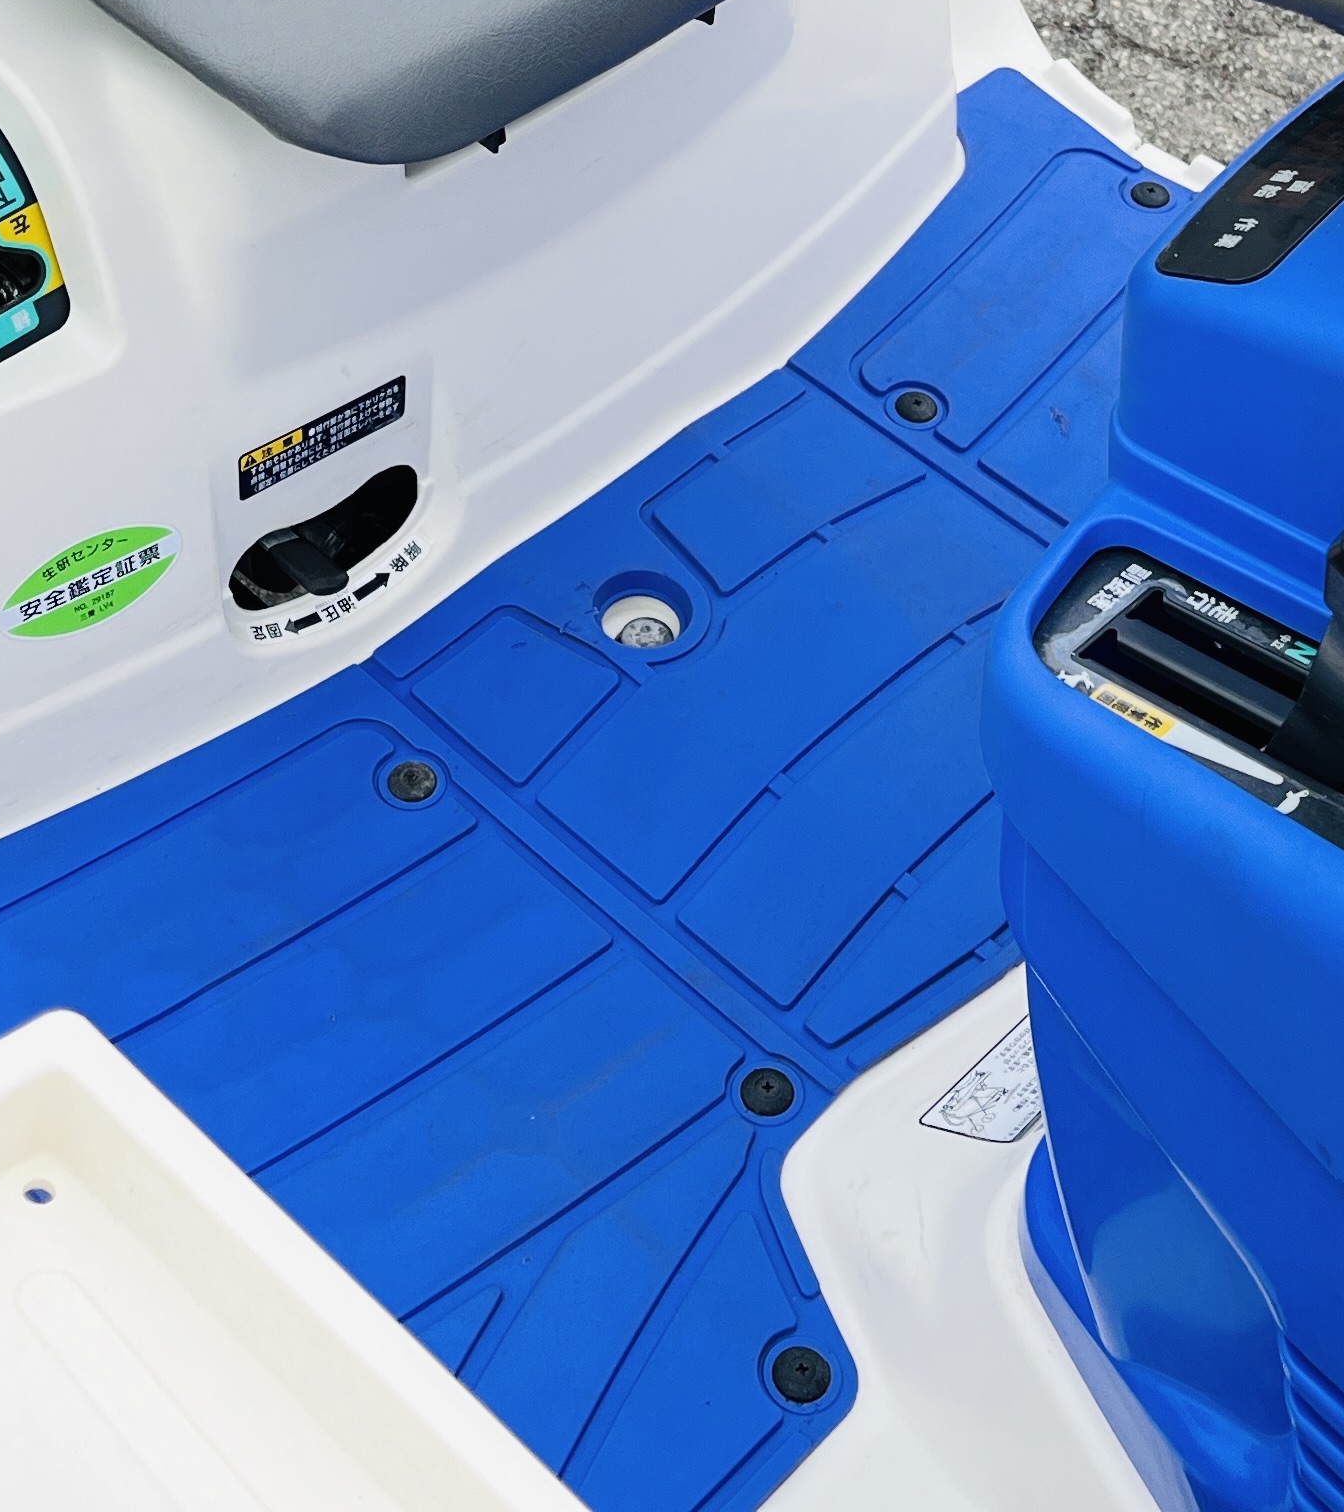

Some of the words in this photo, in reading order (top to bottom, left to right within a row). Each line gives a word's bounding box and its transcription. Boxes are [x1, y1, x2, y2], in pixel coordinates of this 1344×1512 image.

[11, 213, 31, 236] 左
[42, 537, 129, 582] 生研センター
[392, 536, 422, 574] 解除
[19, 543, 161, 622] 安全鑑定証票
[321, 594, 358, 624] 油圧
[1186, 590, 1240, 625] 走行
[251, 622, 282, 641] 固定
[1284, 640, 1319, 667] N
[1095, 691, 1164, 733] 作業範囲
